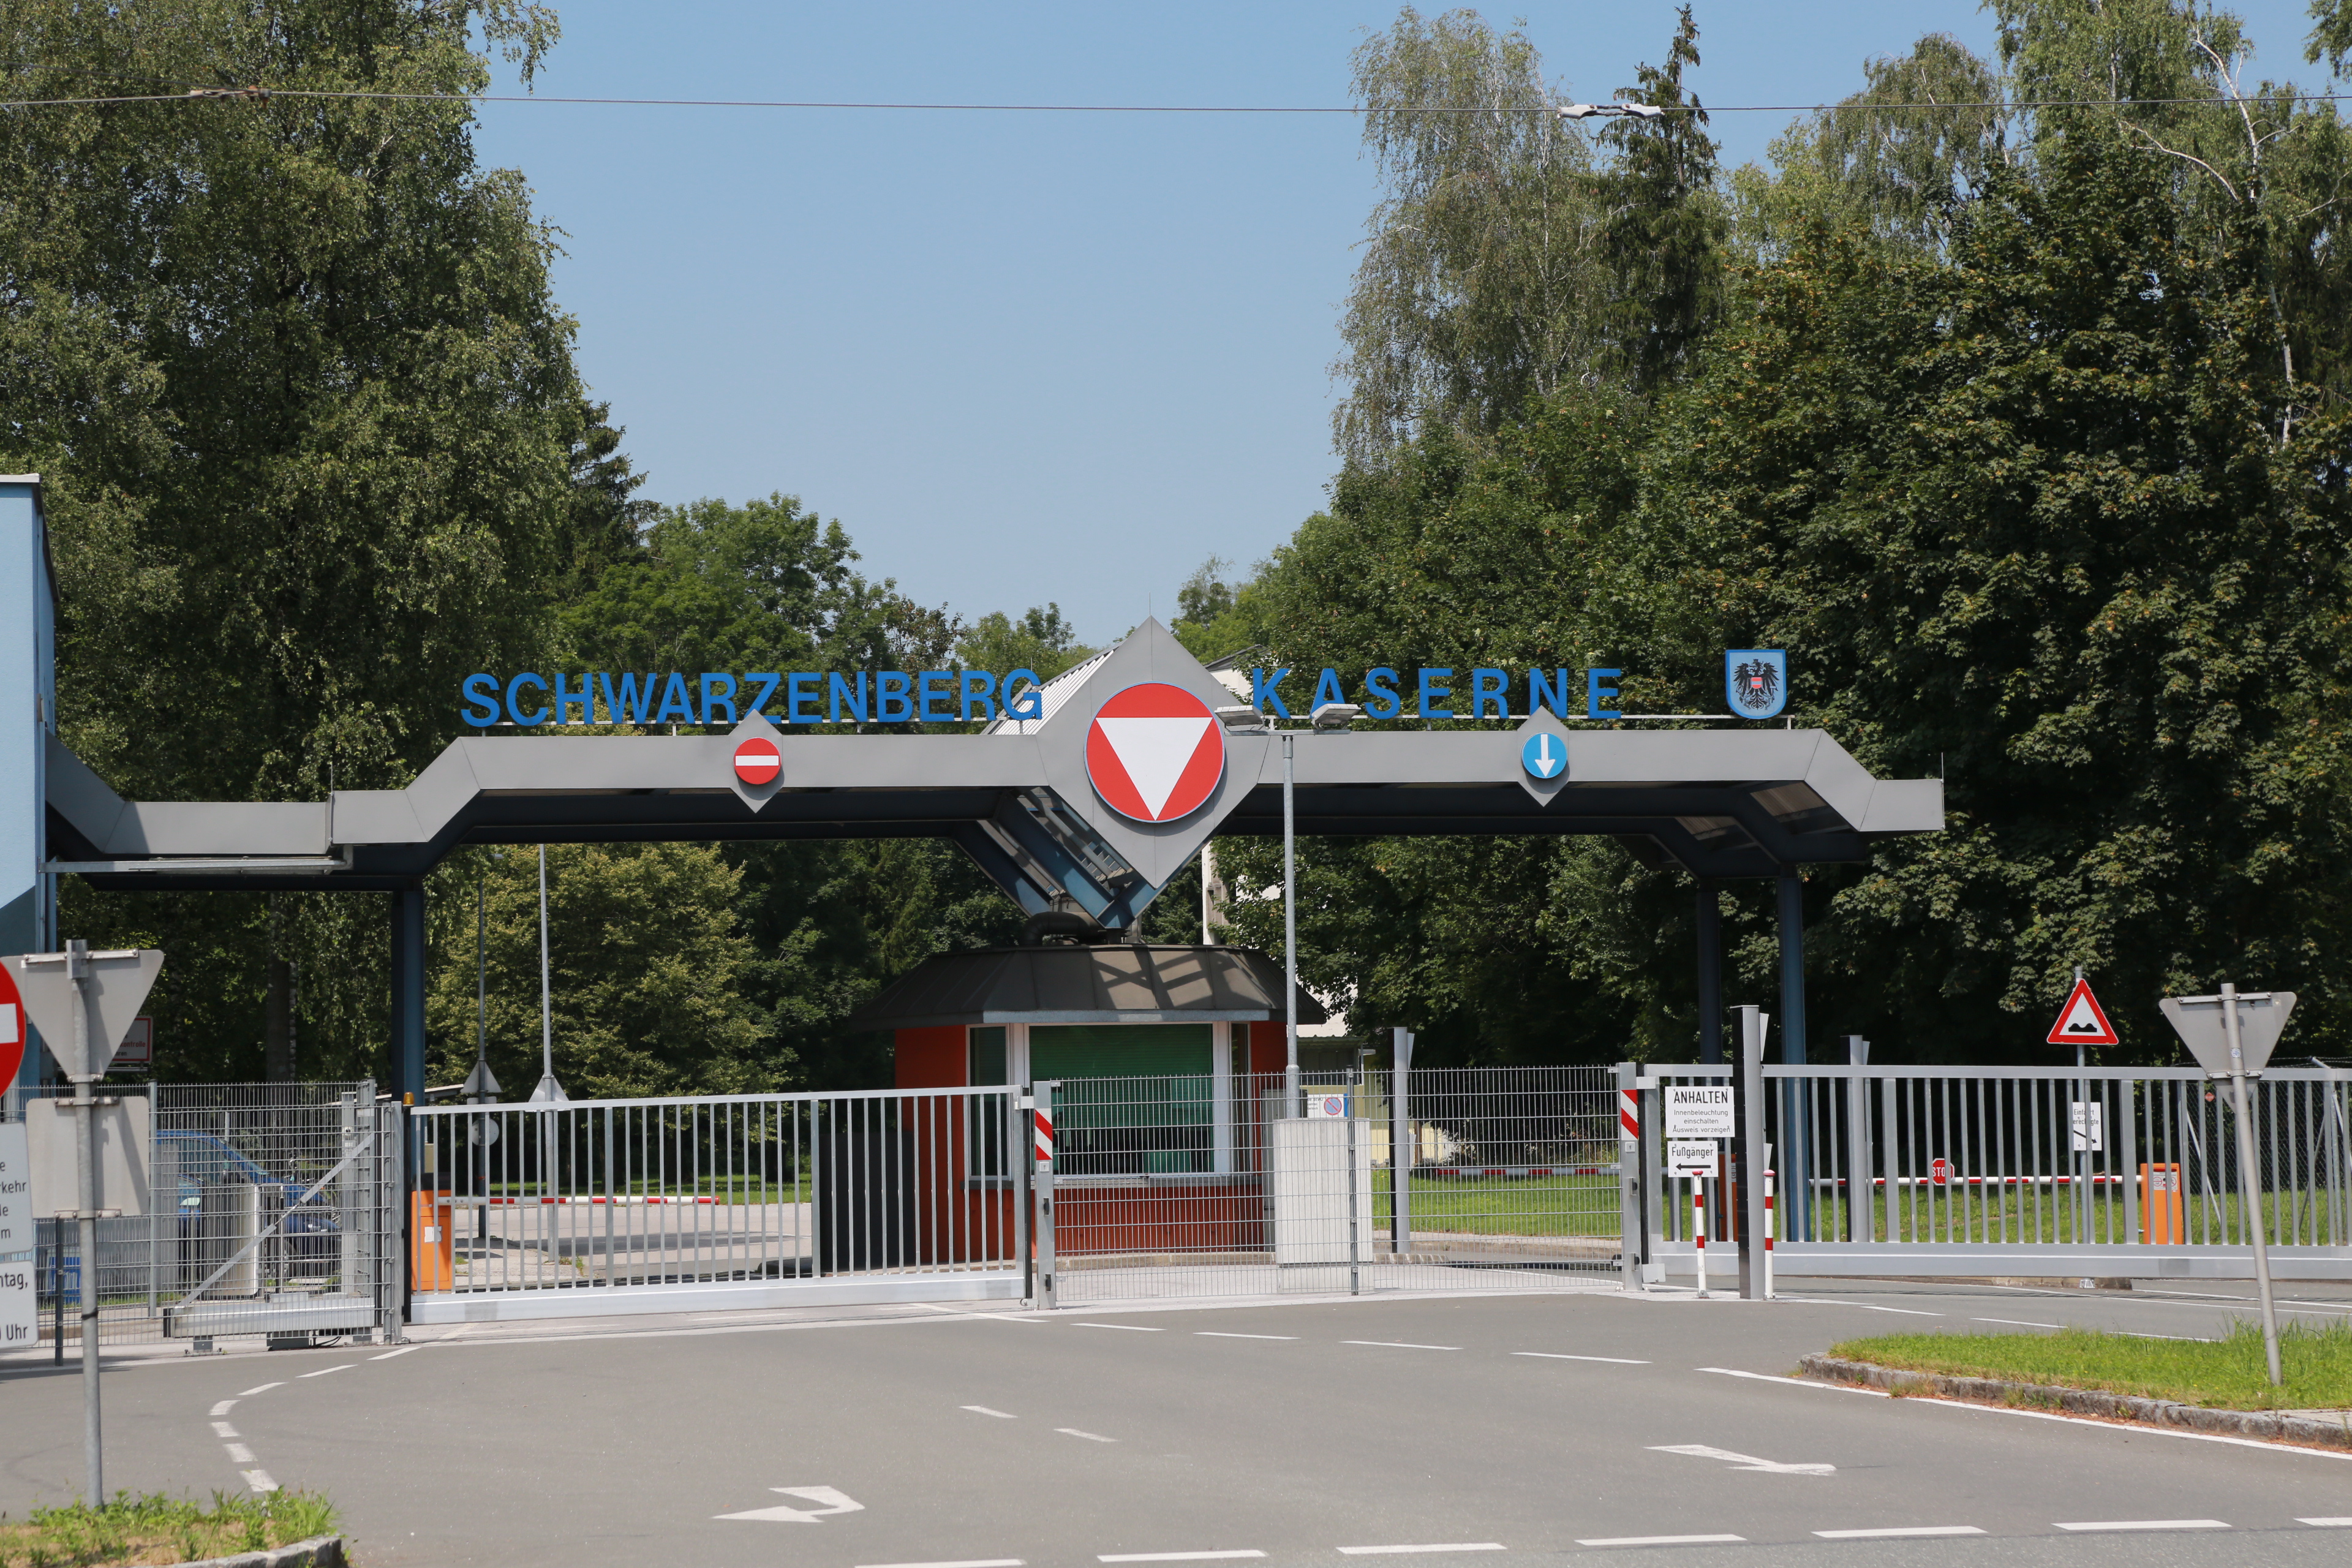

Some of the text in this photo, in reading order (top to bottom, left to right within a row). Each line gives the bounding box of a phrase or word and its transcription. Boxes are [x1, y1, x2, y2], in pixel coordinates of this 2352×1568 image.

[460, 667, 1621, 726] SCHWARZENBERG KASERNE
[1673, 1091, 1728, 1103] ANHALTEN
[1672, 1147, 1714, 1159] Fußgänger
[1932, 1167, 1945, 1177] STO
[0, 1180, 26, 1194] kehr
[6, 1323, 28, 1340] Uhr
